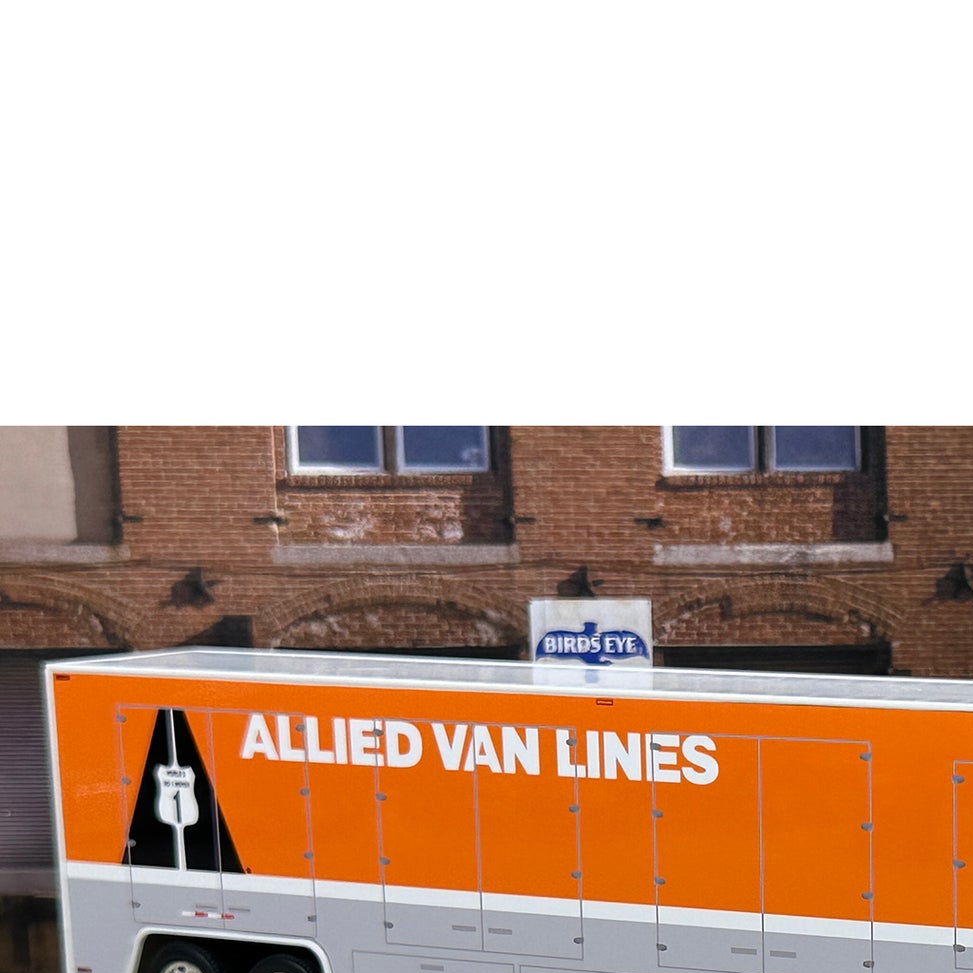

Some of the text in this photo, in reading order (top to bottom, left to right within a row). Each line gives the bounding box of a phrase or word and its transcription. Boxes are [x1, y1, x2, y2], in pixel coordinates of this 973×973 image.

[544, 634, 638, 654] BIRDS EYE
[241, 713, 720, 785] ALLIED VAN LINES
[173, 790, 182, 823] 1
